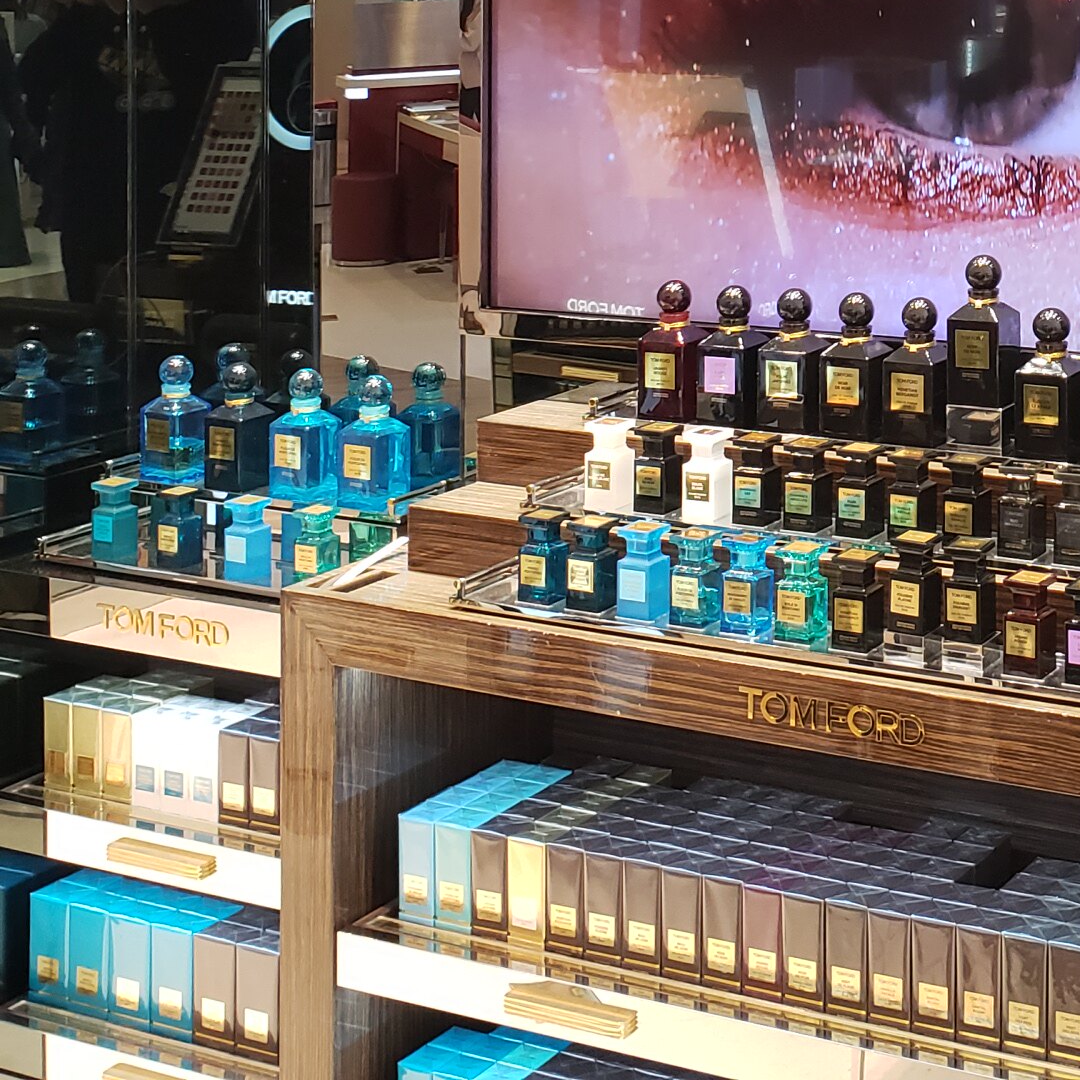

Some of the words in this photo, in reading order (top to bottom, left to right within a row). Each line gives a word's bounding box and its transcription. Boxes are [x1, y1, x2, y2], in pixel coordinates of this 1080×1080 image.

[96, 602, 155, 637] TOM
[158, 613, 229, 647] FORD
[738, 685, 818, 731] TOM
[824, 698, 925, 747] FORD
